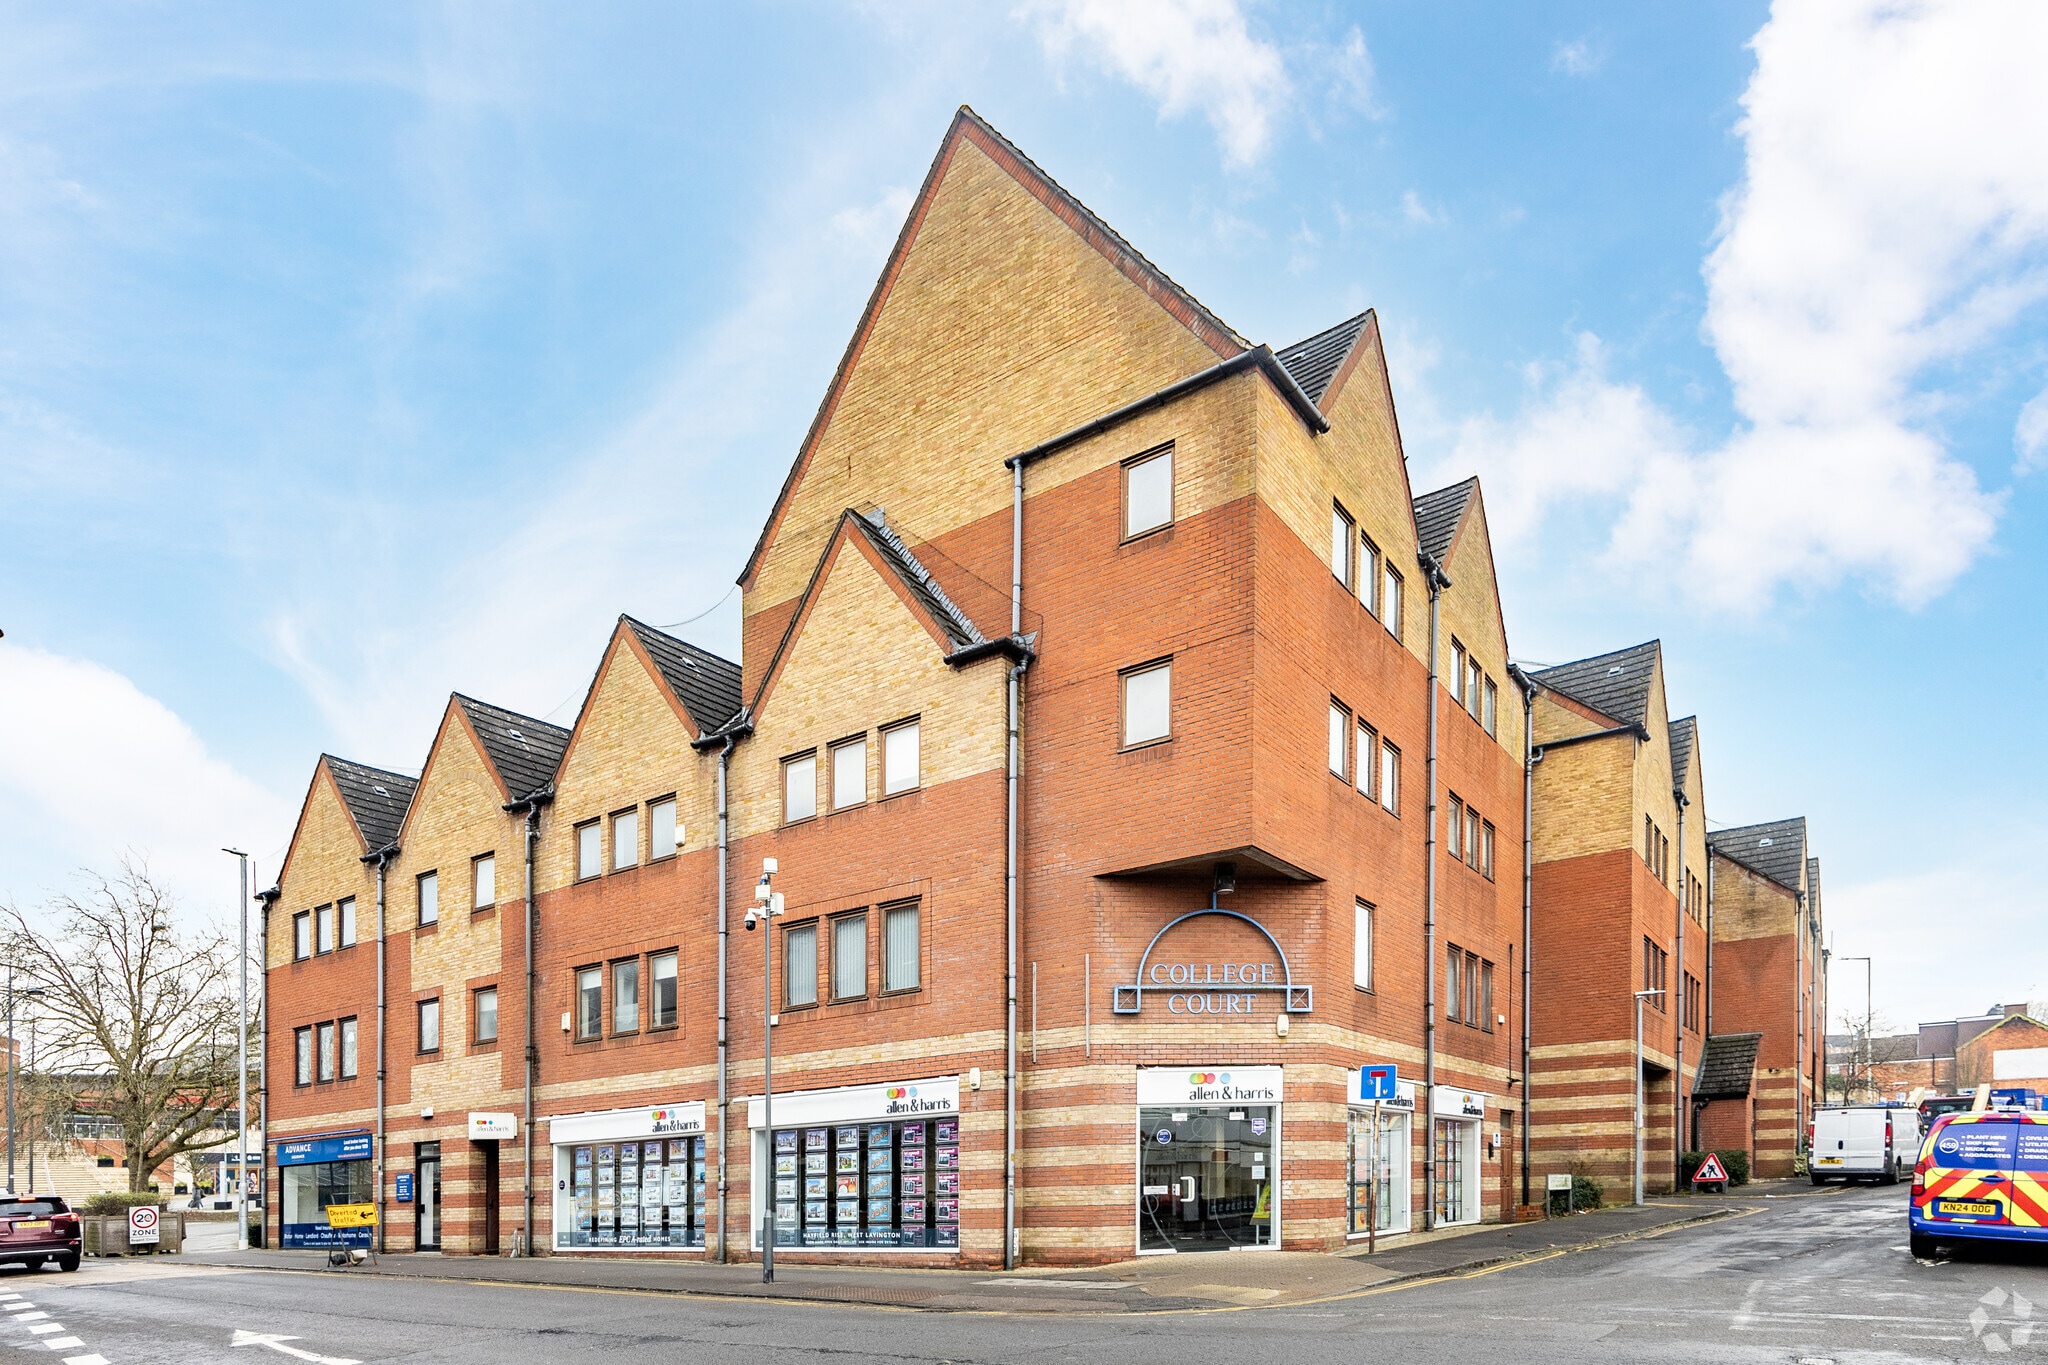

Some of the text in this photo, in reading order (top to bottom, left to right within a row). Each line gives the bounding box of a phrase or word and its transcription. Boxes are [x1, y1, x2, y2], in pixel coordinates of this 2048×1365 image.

[1150, 963, 1276, 984] COLLEGE
[1168, 993, 1257, 1014] COURT
[1189, 1086, 1274, 1101] allen & harris
[886, 1098, 951, 1114] allen & harris
[652, 1120, 699, 1132] allen & harris
[285, 1144, 311, 1153] ADVANCE
[1943, 1203, 1968, 1211] KN24
[136, 1213, 152, 1222] 20
[619, 1235, 630, 1243] EPC
